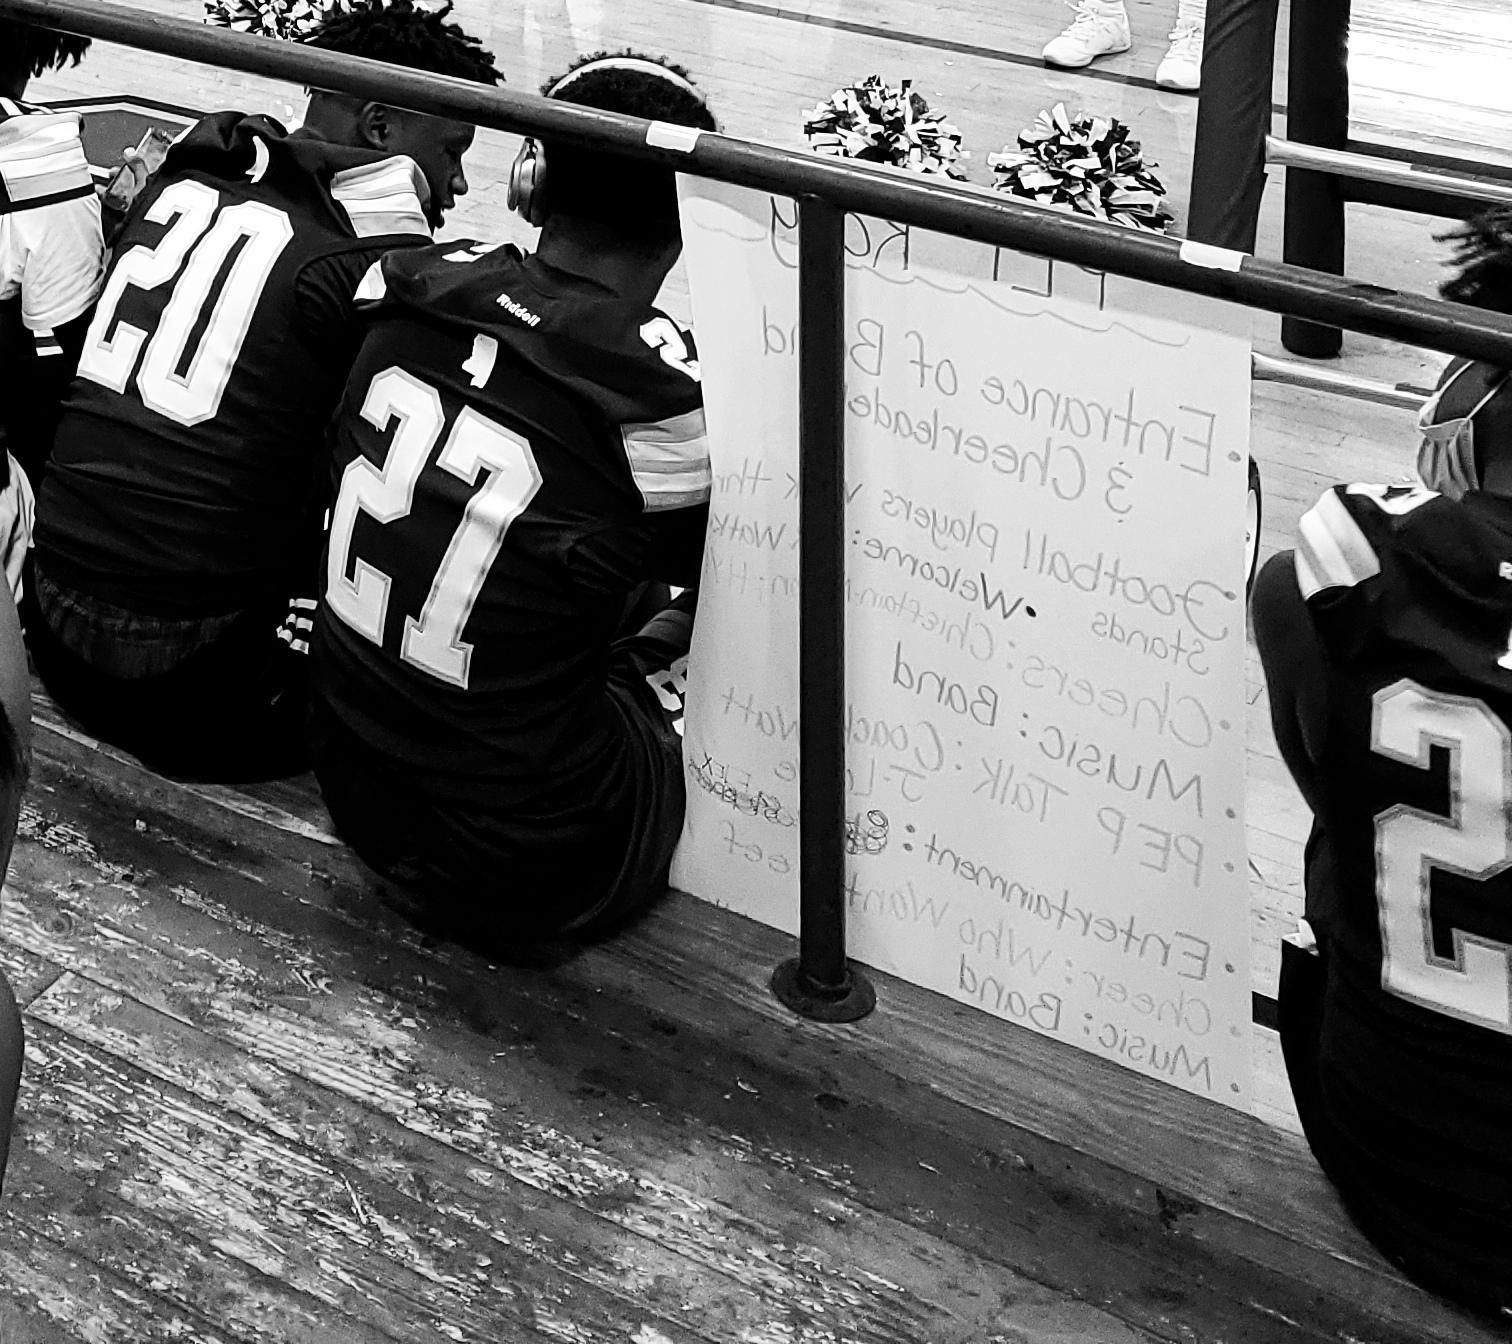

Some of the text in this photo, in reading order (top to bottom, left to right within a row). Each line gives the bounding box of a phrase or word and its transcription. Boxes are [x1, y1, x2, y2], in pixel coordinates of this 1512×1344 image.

[76, 178, 295, 428] 20
[495, 293, 541, 327] Riddell
[326, 365, 544, 691] 27
